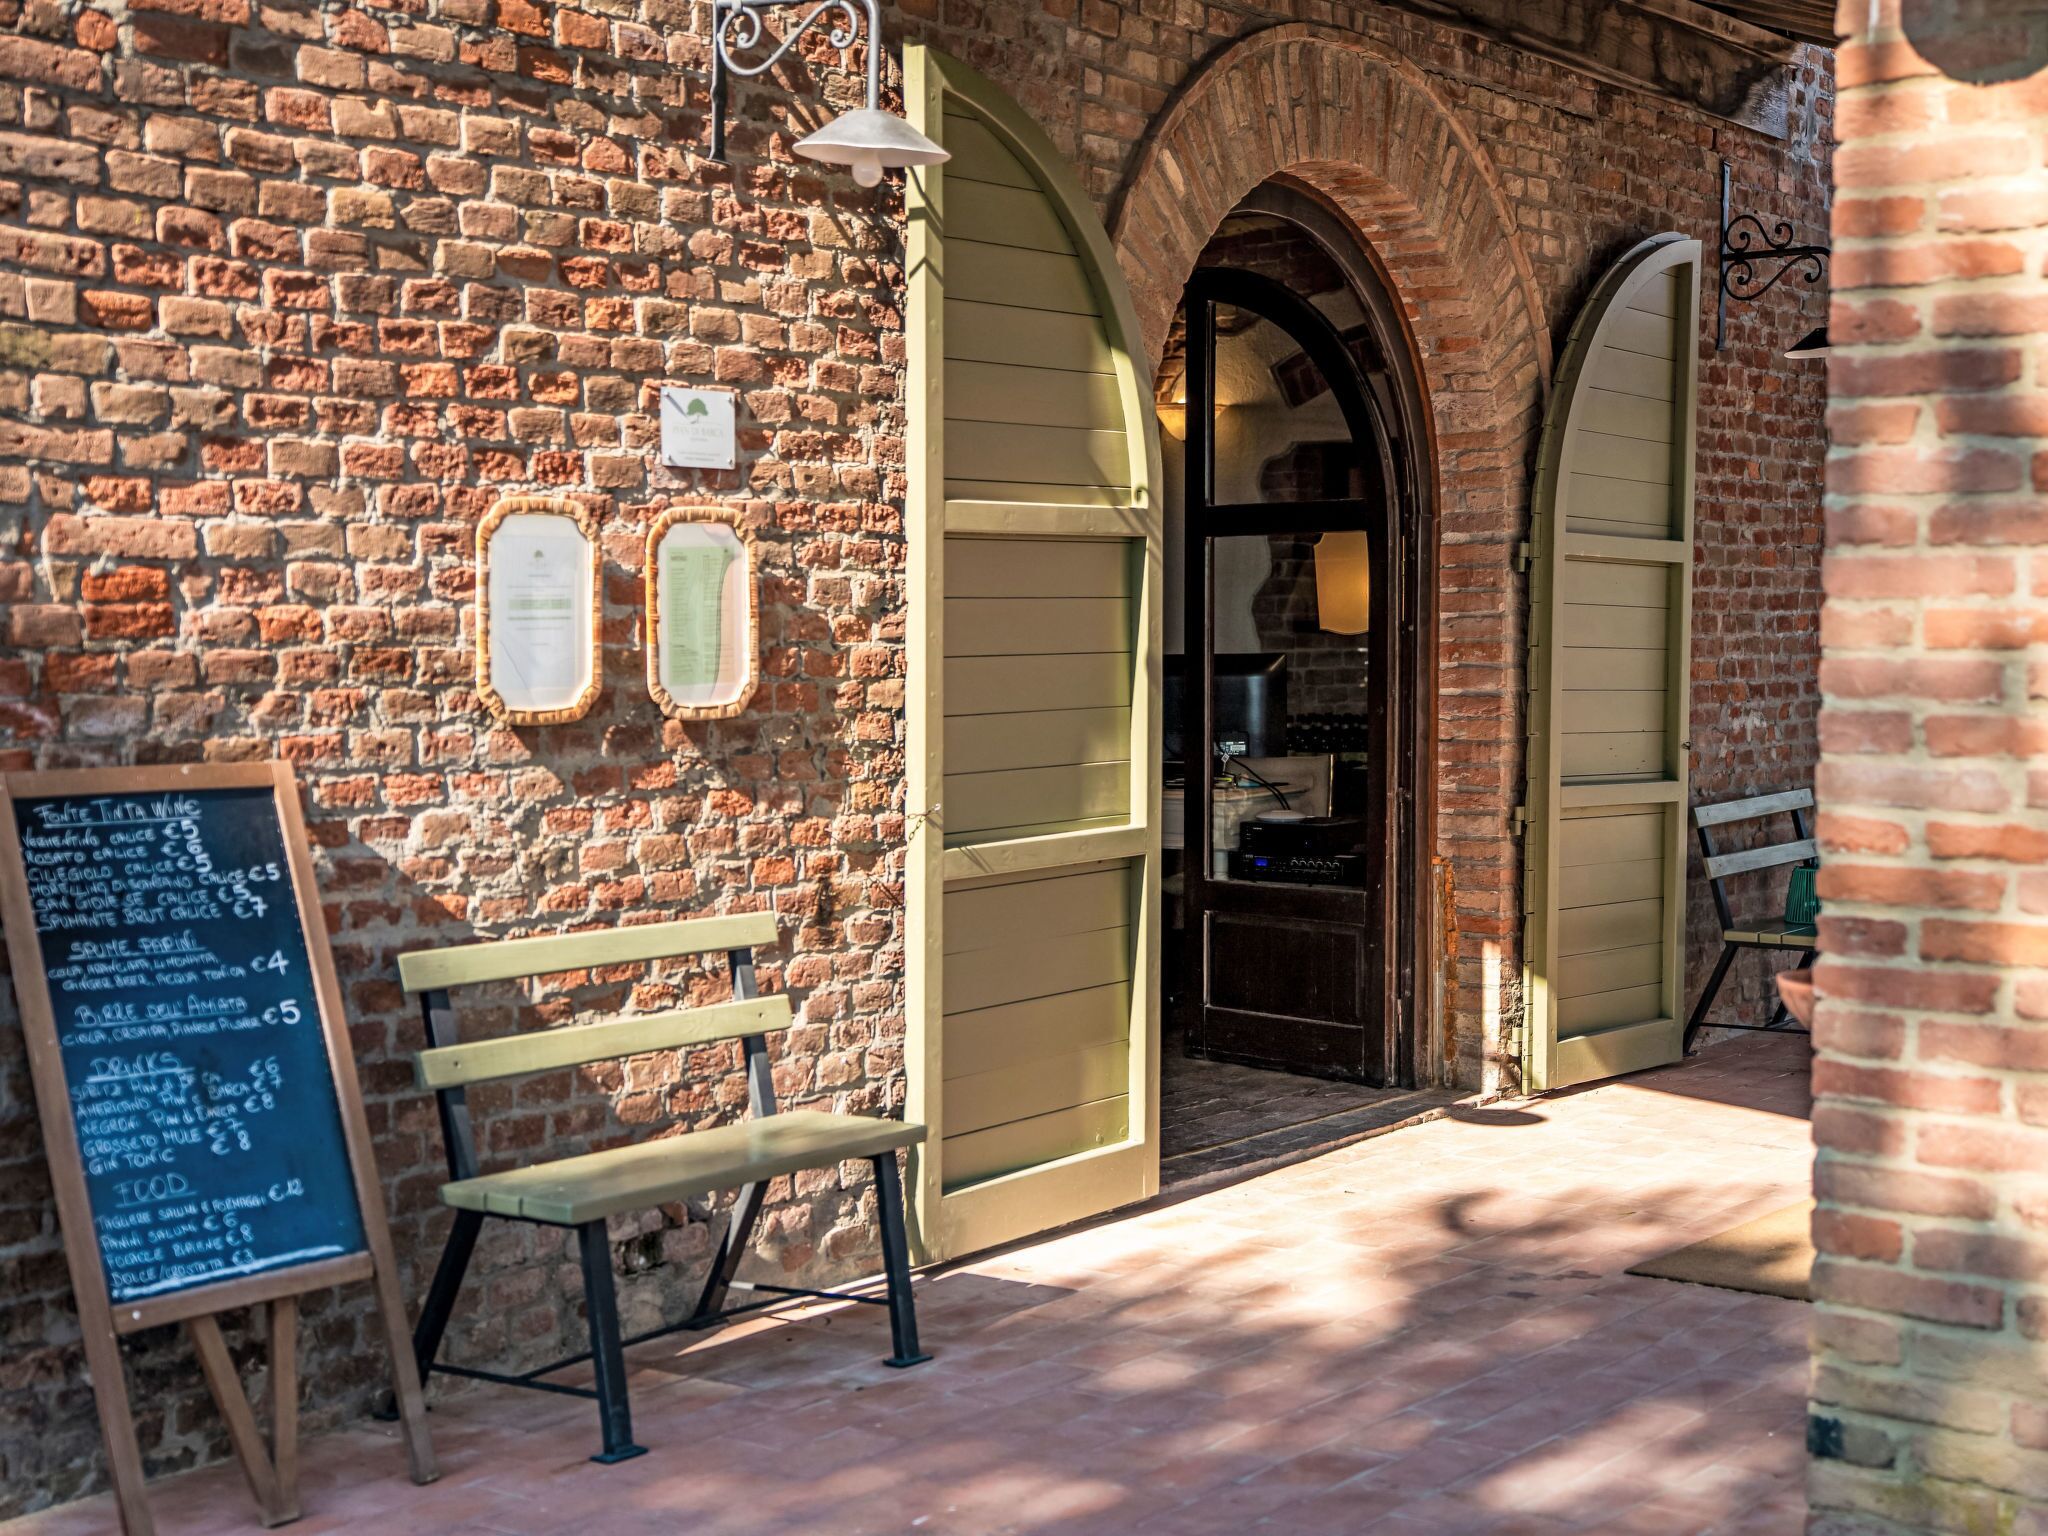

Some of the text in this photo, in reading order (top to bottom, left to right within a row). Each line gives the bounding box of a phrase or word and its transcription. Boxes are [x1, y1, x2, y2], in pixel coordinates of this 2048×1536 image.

[34, 794, 201, 822] FONTE TINTA WINE
[22, 826, 99, 848] VERMENTINO
[110, 828, 156, 846] CALICE
[25, 851, 86, 865] ROSATO
[93, 846, 148, 861] CALICE
[125, 860, 175, 874] CALICE
[112, 879, 126, 892] DI
[199, 869, 247, 885] CALICE
[158, 889, 209, 905] CALICE
[38, 911, 118, 930] SPUMANTE
[123, 907, 165, 925] BRUT
[170, 903, 222, 920] CALICE
[70, 939, 132, 959] SPUME
[74, 1003, 138, 1026] BIRRE
[90, 1051, 182, 1077] DRINKS
[77, 1097, 151, 1119] AMERICANO
[162, 1128, 200, 1145] MULE
[89, 1156, 119, 1176] GIN
[123, 1149, 175, 1169] TONIC
[113, 1173, 188, 1205] FOOD
[101, 1232, 142, 1251] PANINI
